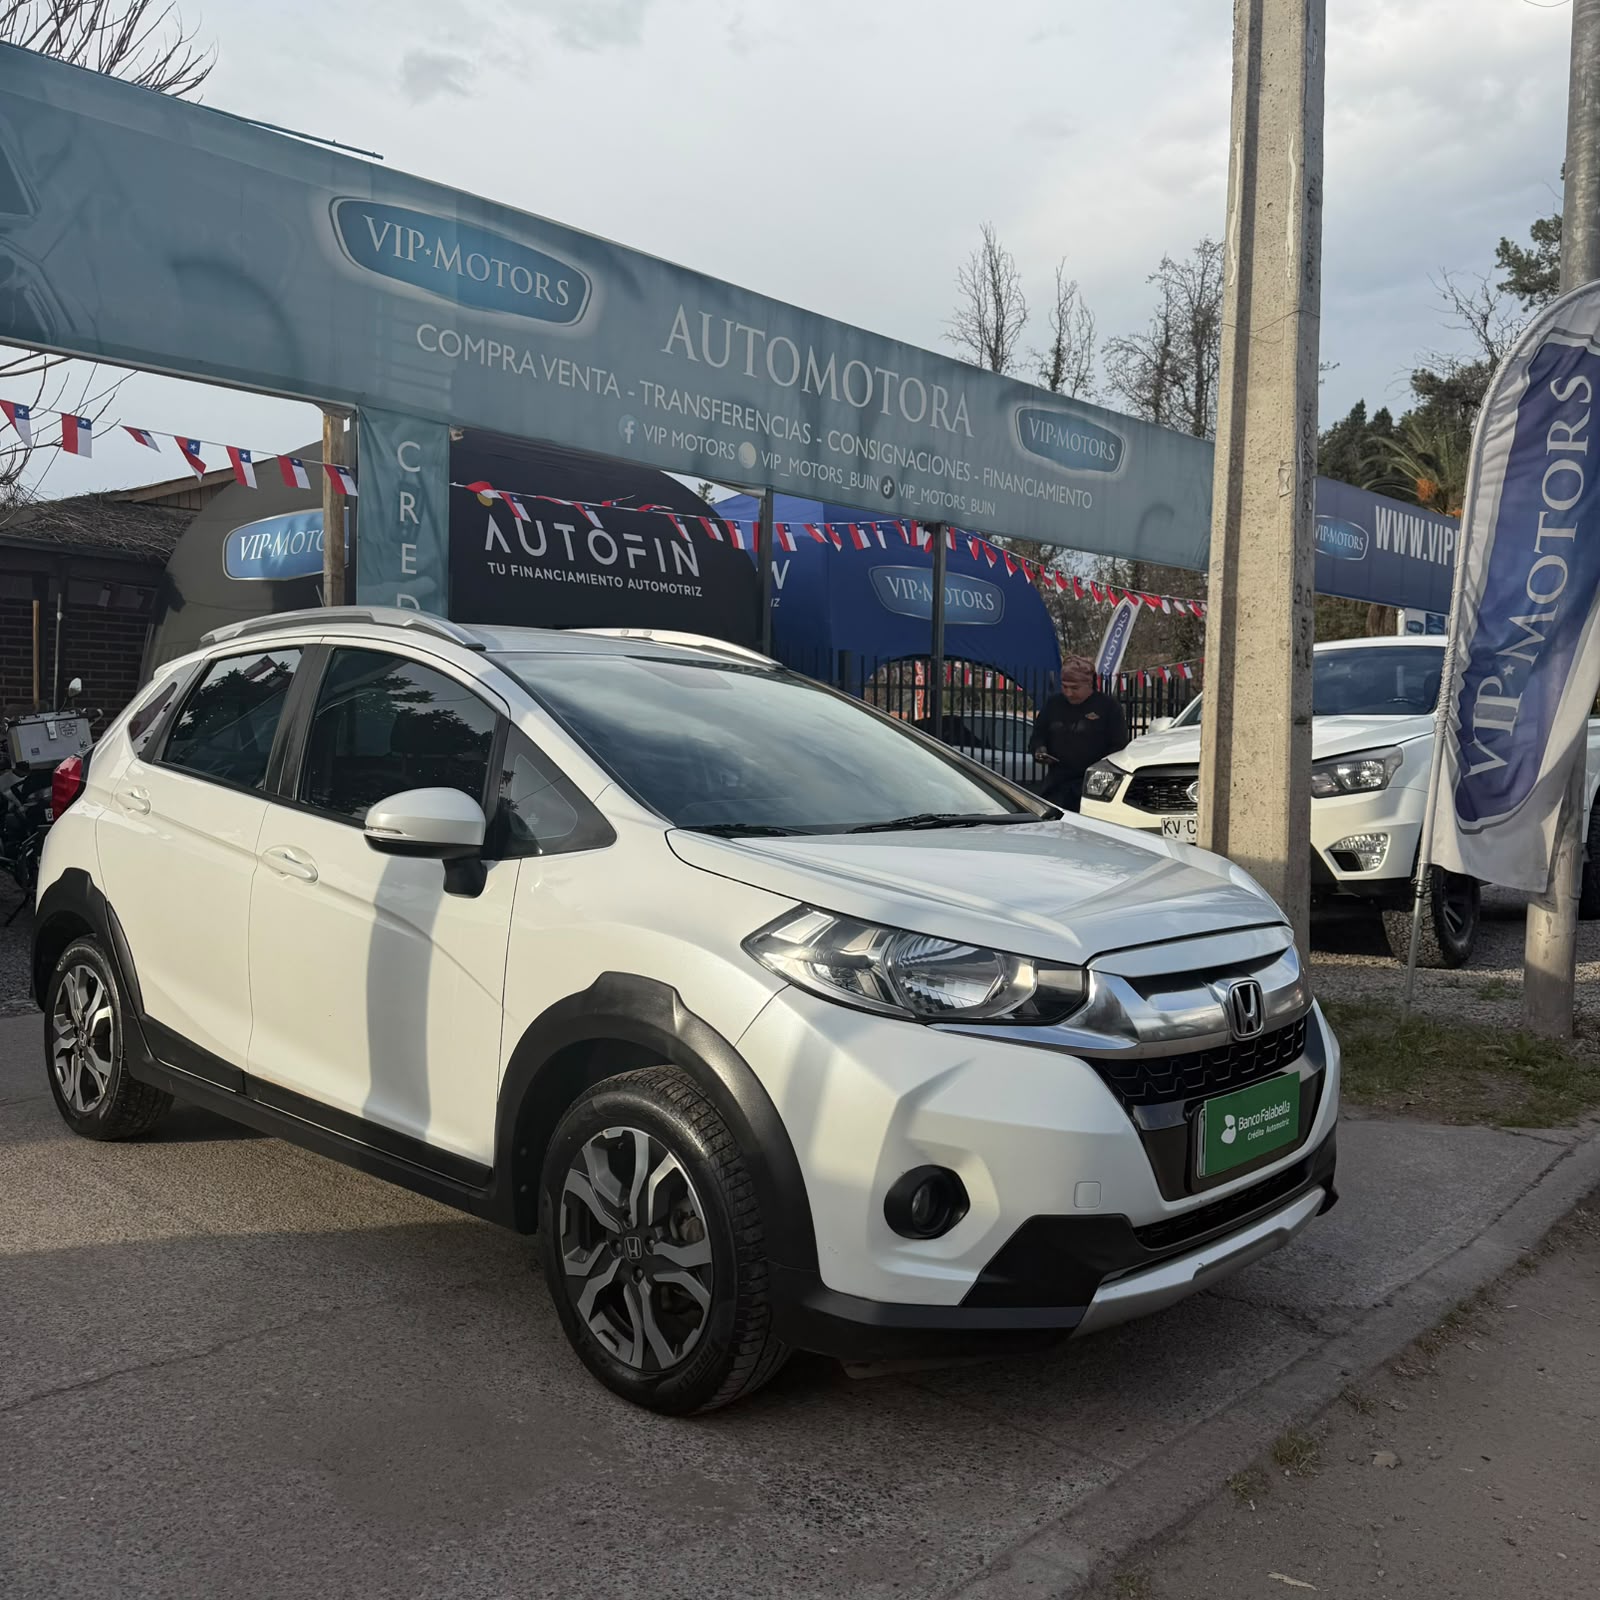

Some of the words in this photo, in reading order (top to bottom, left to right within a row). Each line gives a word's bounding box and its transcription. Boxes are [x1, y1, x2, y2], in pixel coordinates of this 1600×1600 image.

[362, 214, 425, 263] VIP
[432, 236, 570, 306] MOTORS
[660, 303, 976, 438] AUTOMOTORA
[639, 380, 811, 444] TRANSFERENCIAS
[827, 430, 970, 482] CONSIGNACIONES
[983, 467, 1093, 509] FINANCIAMIENTO
[643, 423, 667, 445] VIP
[672, 430, 735, 461] MOTORS
[1028, 416, 1054, 444] VIP
[1056, 426, 1116, 462] MOTORS
[760, 450, 880, 492] VIP_MOTORS_BUIN
[240, 533, 271, 561] VIP
[270, 529, 325, 558] MOTO
[484, 514, 700, 578] AUTOFIN
[1328, 527, 1364, 551] MOTORS
[487, 562, 506, 575] TU
[510, 564, 624, 589] FINANCIAMIENTO
[627, 578, 703, 598] AUTOMOTRIZ
[885, 575, 918, 600] VIP
[1465, 677, 1523, 778] VIP
[1497, 374, 1593, 666] MOTORS
